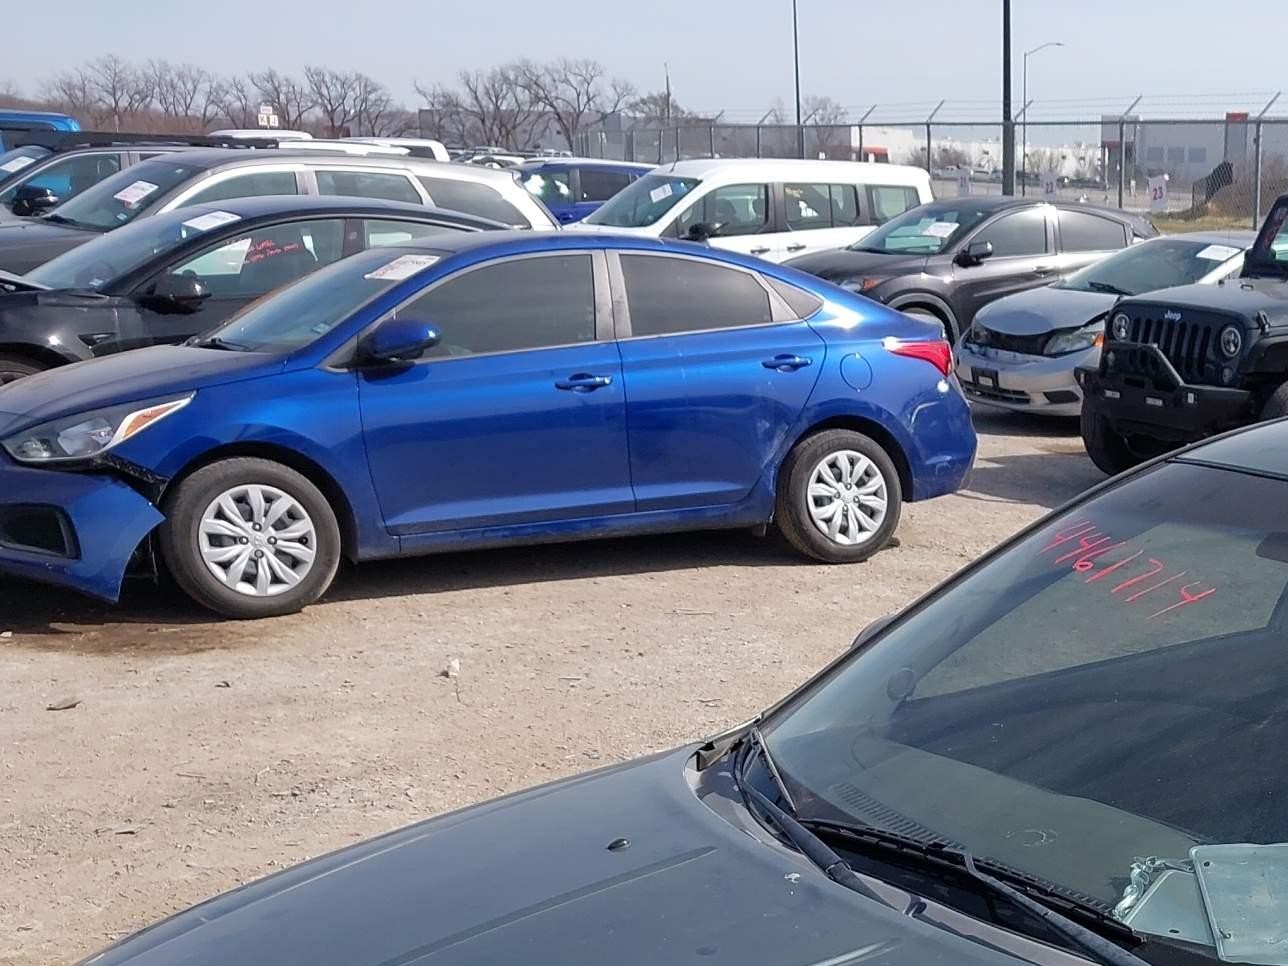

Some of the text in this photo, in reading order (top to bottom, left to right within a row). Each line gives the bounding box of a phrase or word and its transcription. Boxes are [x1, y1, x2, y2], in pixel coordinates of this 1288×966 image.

[1152, 186, 1164, 201] 23
[1164, 309, 1182, 321] Jeep
[1039, 516, 1217, 620] 4461714
